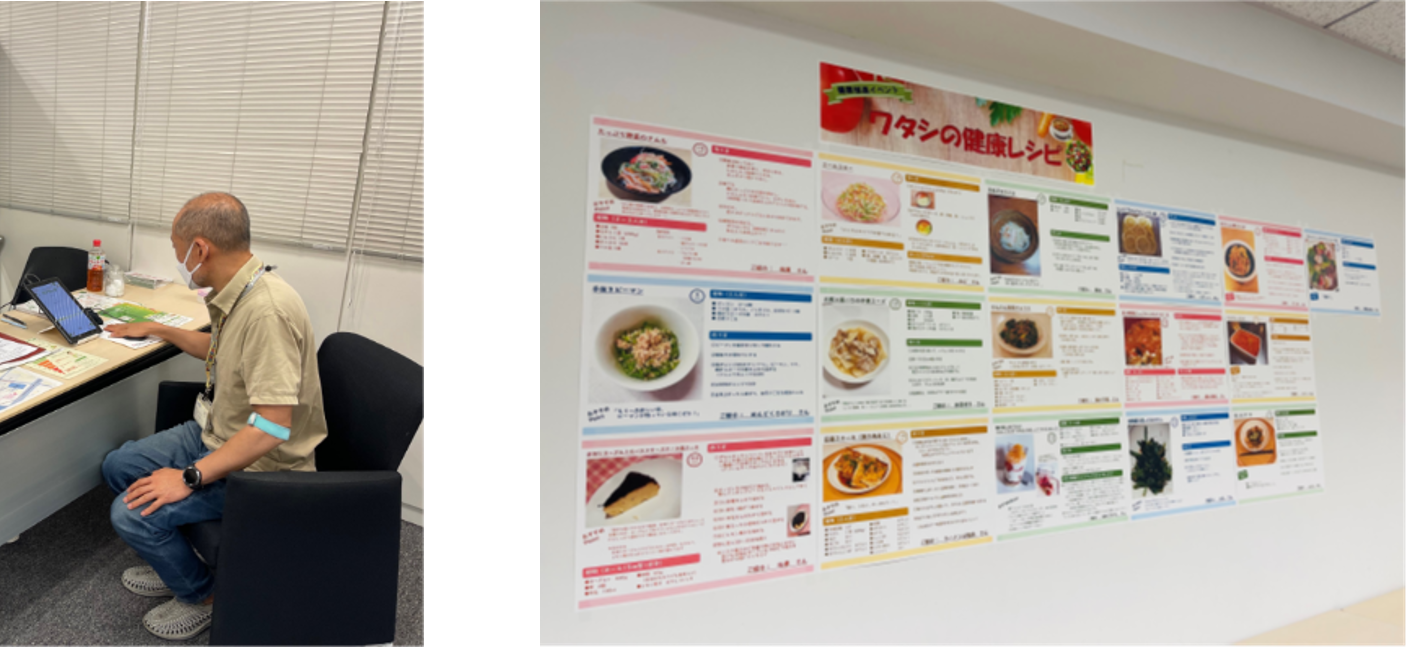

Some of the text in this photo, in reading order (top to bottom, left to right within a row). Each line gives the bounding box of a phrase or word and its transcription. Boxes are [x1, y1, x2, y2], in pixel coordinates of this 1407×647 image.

[869, 109, 1063, 168] ワタシの健康レシピ
